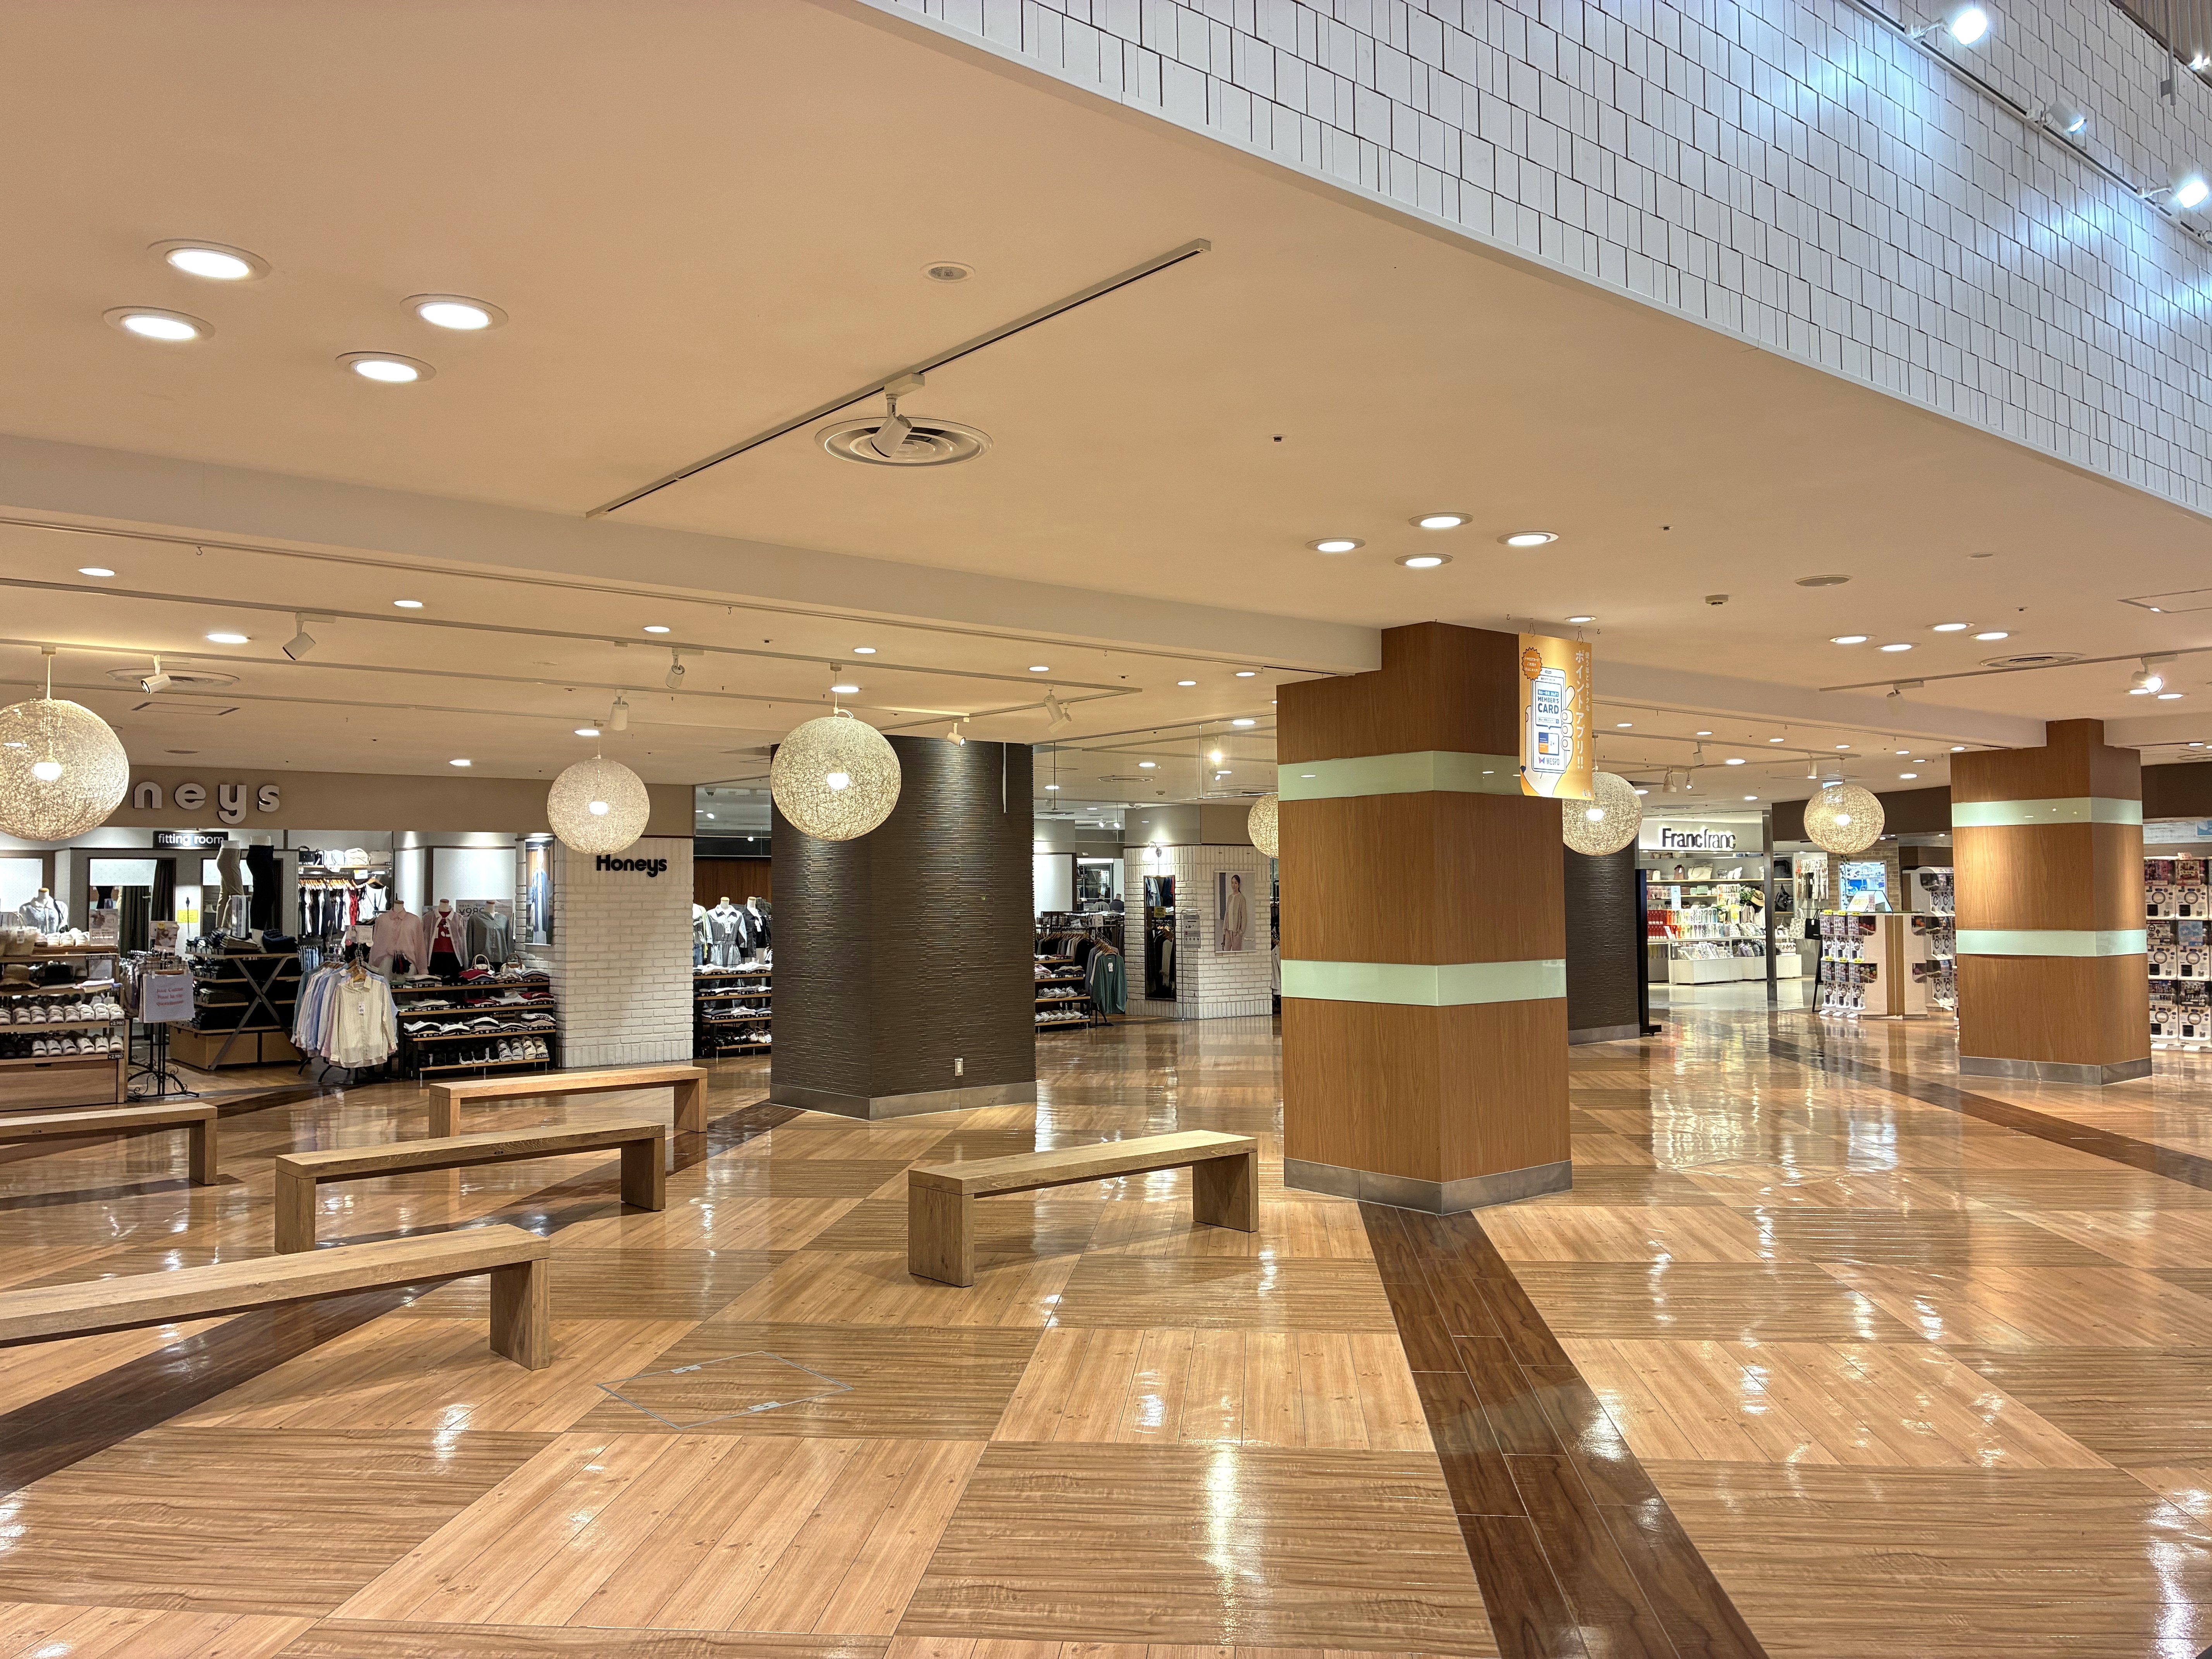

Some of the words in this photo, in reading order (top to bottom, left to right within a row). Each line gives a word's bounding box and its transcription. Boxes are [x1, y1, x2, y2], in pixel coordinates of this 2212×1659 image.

[1538, 703, 1559, 714] CARD
[1576, 650, 1585, 769] ポイントアプリ!!
[133, 781, 280, 824] neys
[158, 833, 191, 847] fitting
[194, 835, 224, 845] room
[1662, 828, 1736, 849] Francfranc
[596, 854, 667, 878] Honeys
